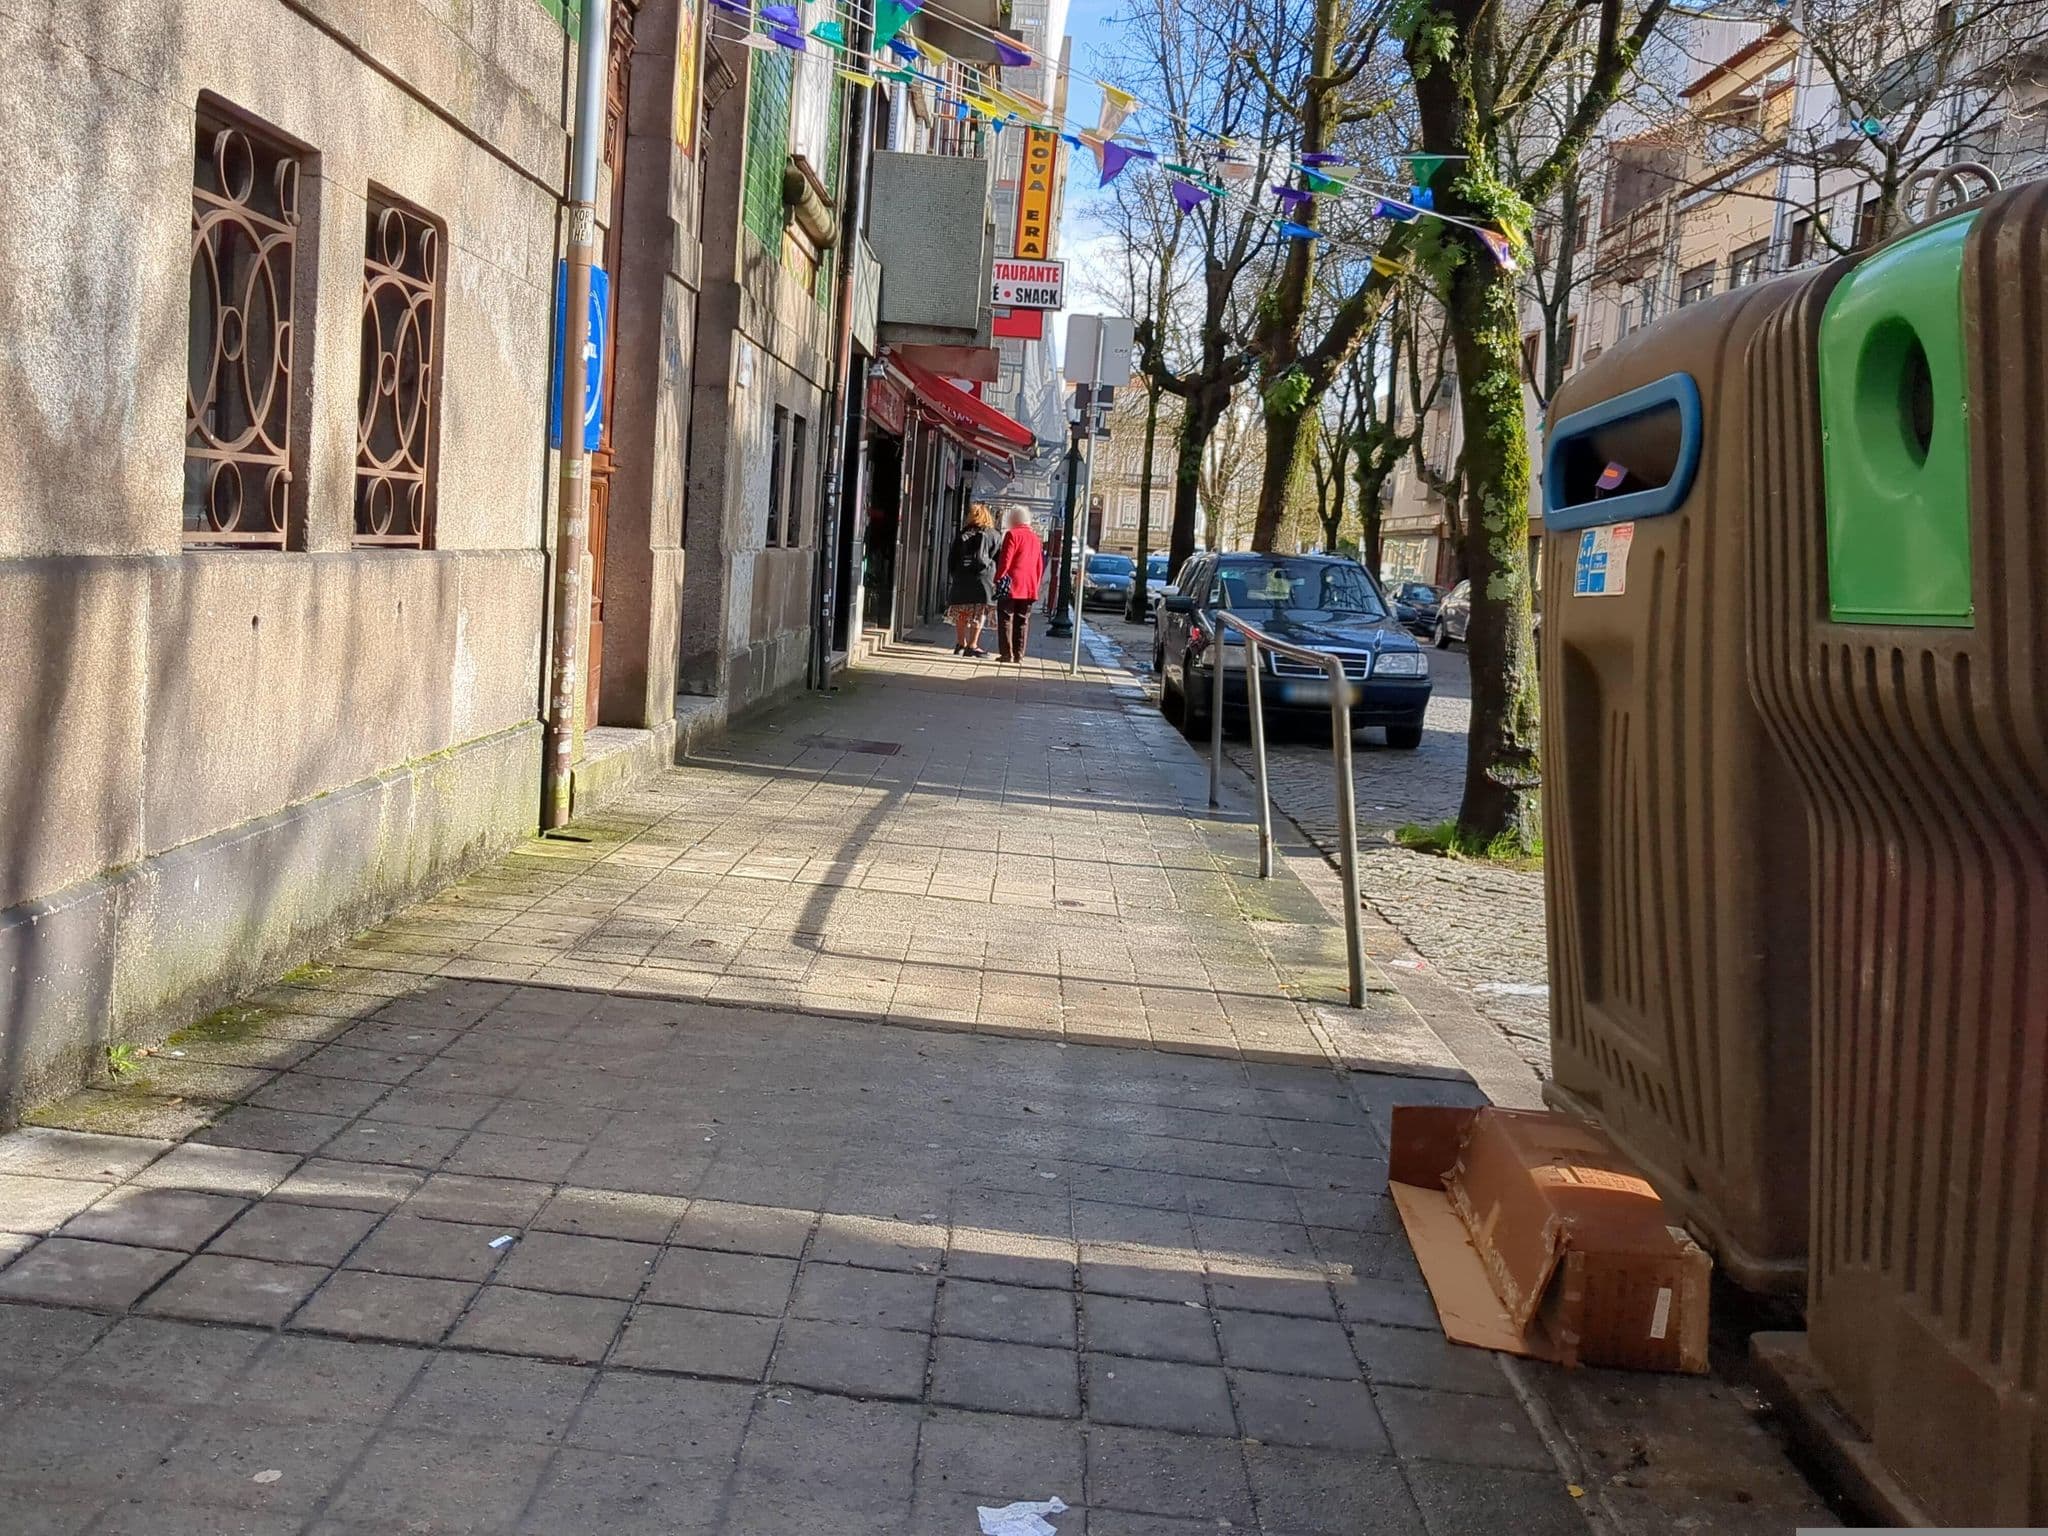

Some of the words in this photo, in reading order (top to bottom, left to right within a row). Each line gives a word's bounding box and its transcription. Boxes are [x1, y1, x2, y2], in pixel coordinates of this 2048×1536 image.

[1028, 131, 1050, 191] NOVA
[1023, 210, 1040, 253] ERA
[993, 264, 1059, 283] TAURANTE
[1016, 288, 1057, 304] SNACK
